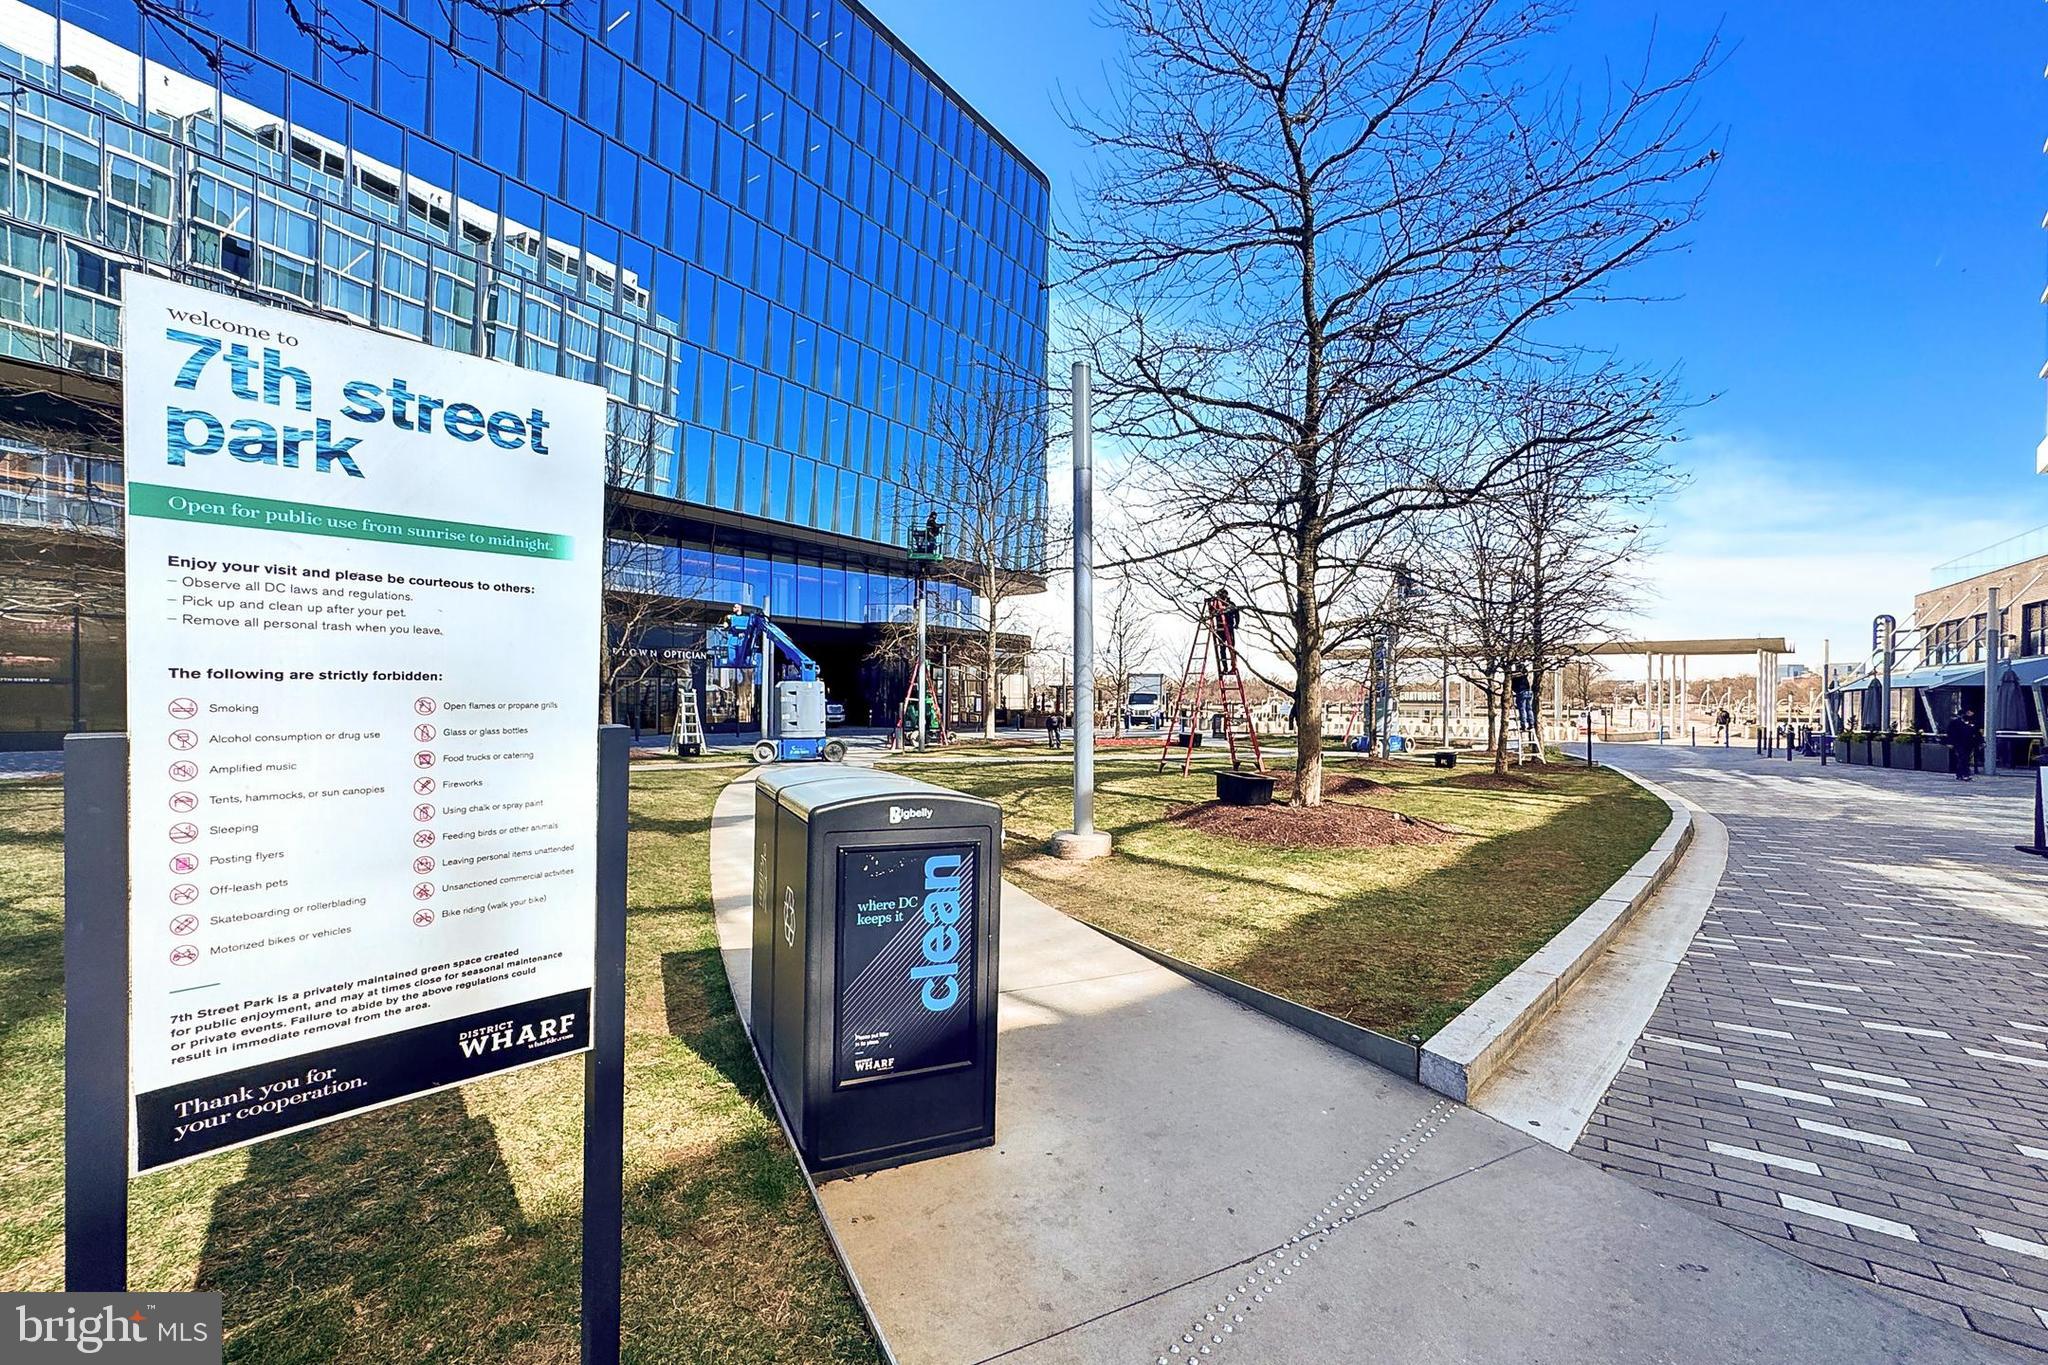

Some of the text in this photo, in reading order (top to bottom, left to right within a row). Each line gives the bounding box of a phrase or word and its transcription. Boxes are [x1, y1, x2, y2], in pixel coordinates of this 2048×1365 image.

[166, 308, 298, 346] welcome to
[166, 328, 550, 455] 7th street
[167, 406, 365, 479] park
[169, 497, 554, 552] Open for public use from sunrise to midnight.
[168, 555, 534, 594] Enjoy your visit and please be courteous to others:
[182, 576, 413, 601] Observe all DC laws and regulations.
[183, 595, 406, 619] Pick up and clean up after your pet.
[183, 614, 443, 635] Remove all personal trash when you leave.
[663, 649, 707, 660] OPTICIAN
[168, 668, 442, 682] The following are strictly forbidden:
[209, 704, 258, 714] Smoking
[444, 702, 466, 711] Open
[209, 734, 251, 743] Alcohol
[255, 733, 322, 743] consumption
[338, 732, 360, 741] drug
[443, 728, 500, 737] Glass glass
[443, 754, 464, 762] Food
[209, 763, 296, 775] Amplified music
[443, 780, 483, 788] Fireworks
[209, 795, 242, 804] Tents,
[246, 791, 305, 802] hammocks,
[342, 787, 385, 796] canopies
[443, 804, 490, 815] Using chalk
[890, 806, 934, 824] Bigbelly
[210, 825, 258, 835] Sleeping
[443, 829, 497, 840] Feeding birds
[210, 852, 284, 865] Posting flyers
[442, 852, 510, 866] Leaving personal
[210, 880, 288, 895] Off-leash pets
[442, 878, 497, 892] Unsanctioned
[210, 909, 290, 925] Skateboarding
[307, 898, 366, 911] rollerblading
[442, 902, 508, 918] Bike riding (walk
[858, 896, 918, 912] where DC
[857, 911, 903, 926] keeps it
[210, 939, 264, 955] Motorized
[268, 936, 295, 946] bikes
[312, 927, 351, 938] vehicles
[910, 854, 962, 1012] clean
[170, 1013, 192, 1024] 7th
[197, 1003, 239, 1018] Street
[244, 997, 273, 1009] Park
[304, 982, 353, 999] privately
[357, 967, 418, 987] maintained
[421, 963, 450, 975] green
[453, 957, 481, 968] space
[484, 948, 519, 961] created
[171, 951, 563, 1037] for public enjoyment, and may at times close for seasonal maintenance
[171, 1042, 186, 1051] or
[190, 1032, 236, 1051] private
[241, 1022, 286, 1036] events.
[291, 1012, 332, 1025] Failure
[352, 1001, 382, 1012] abide
[386, 997, 399, 1005] by
[402, 993, 419, 1001] the
[422, 986, 452, 997] above
[455, 972, 509, 990] regulations
[511, 967, 536, 977] could
[172, 1049, 211, 1064] result
[232, 1028, 300, 1051] immediate
[304, 1018, 350, 1035] removal
[355, 1013, 380, 1023] from
[405, 1002, 430, 1012] area.
[459, 1014, 575, 1058] WHARF
[460, 1021, 513, 1040] DISTRICT
[855, 1058, 894, 1072] WHARF
[174, 1069, 337, 1119] Thank you for
[174, 1078, 368, 1141] your cooperation.
